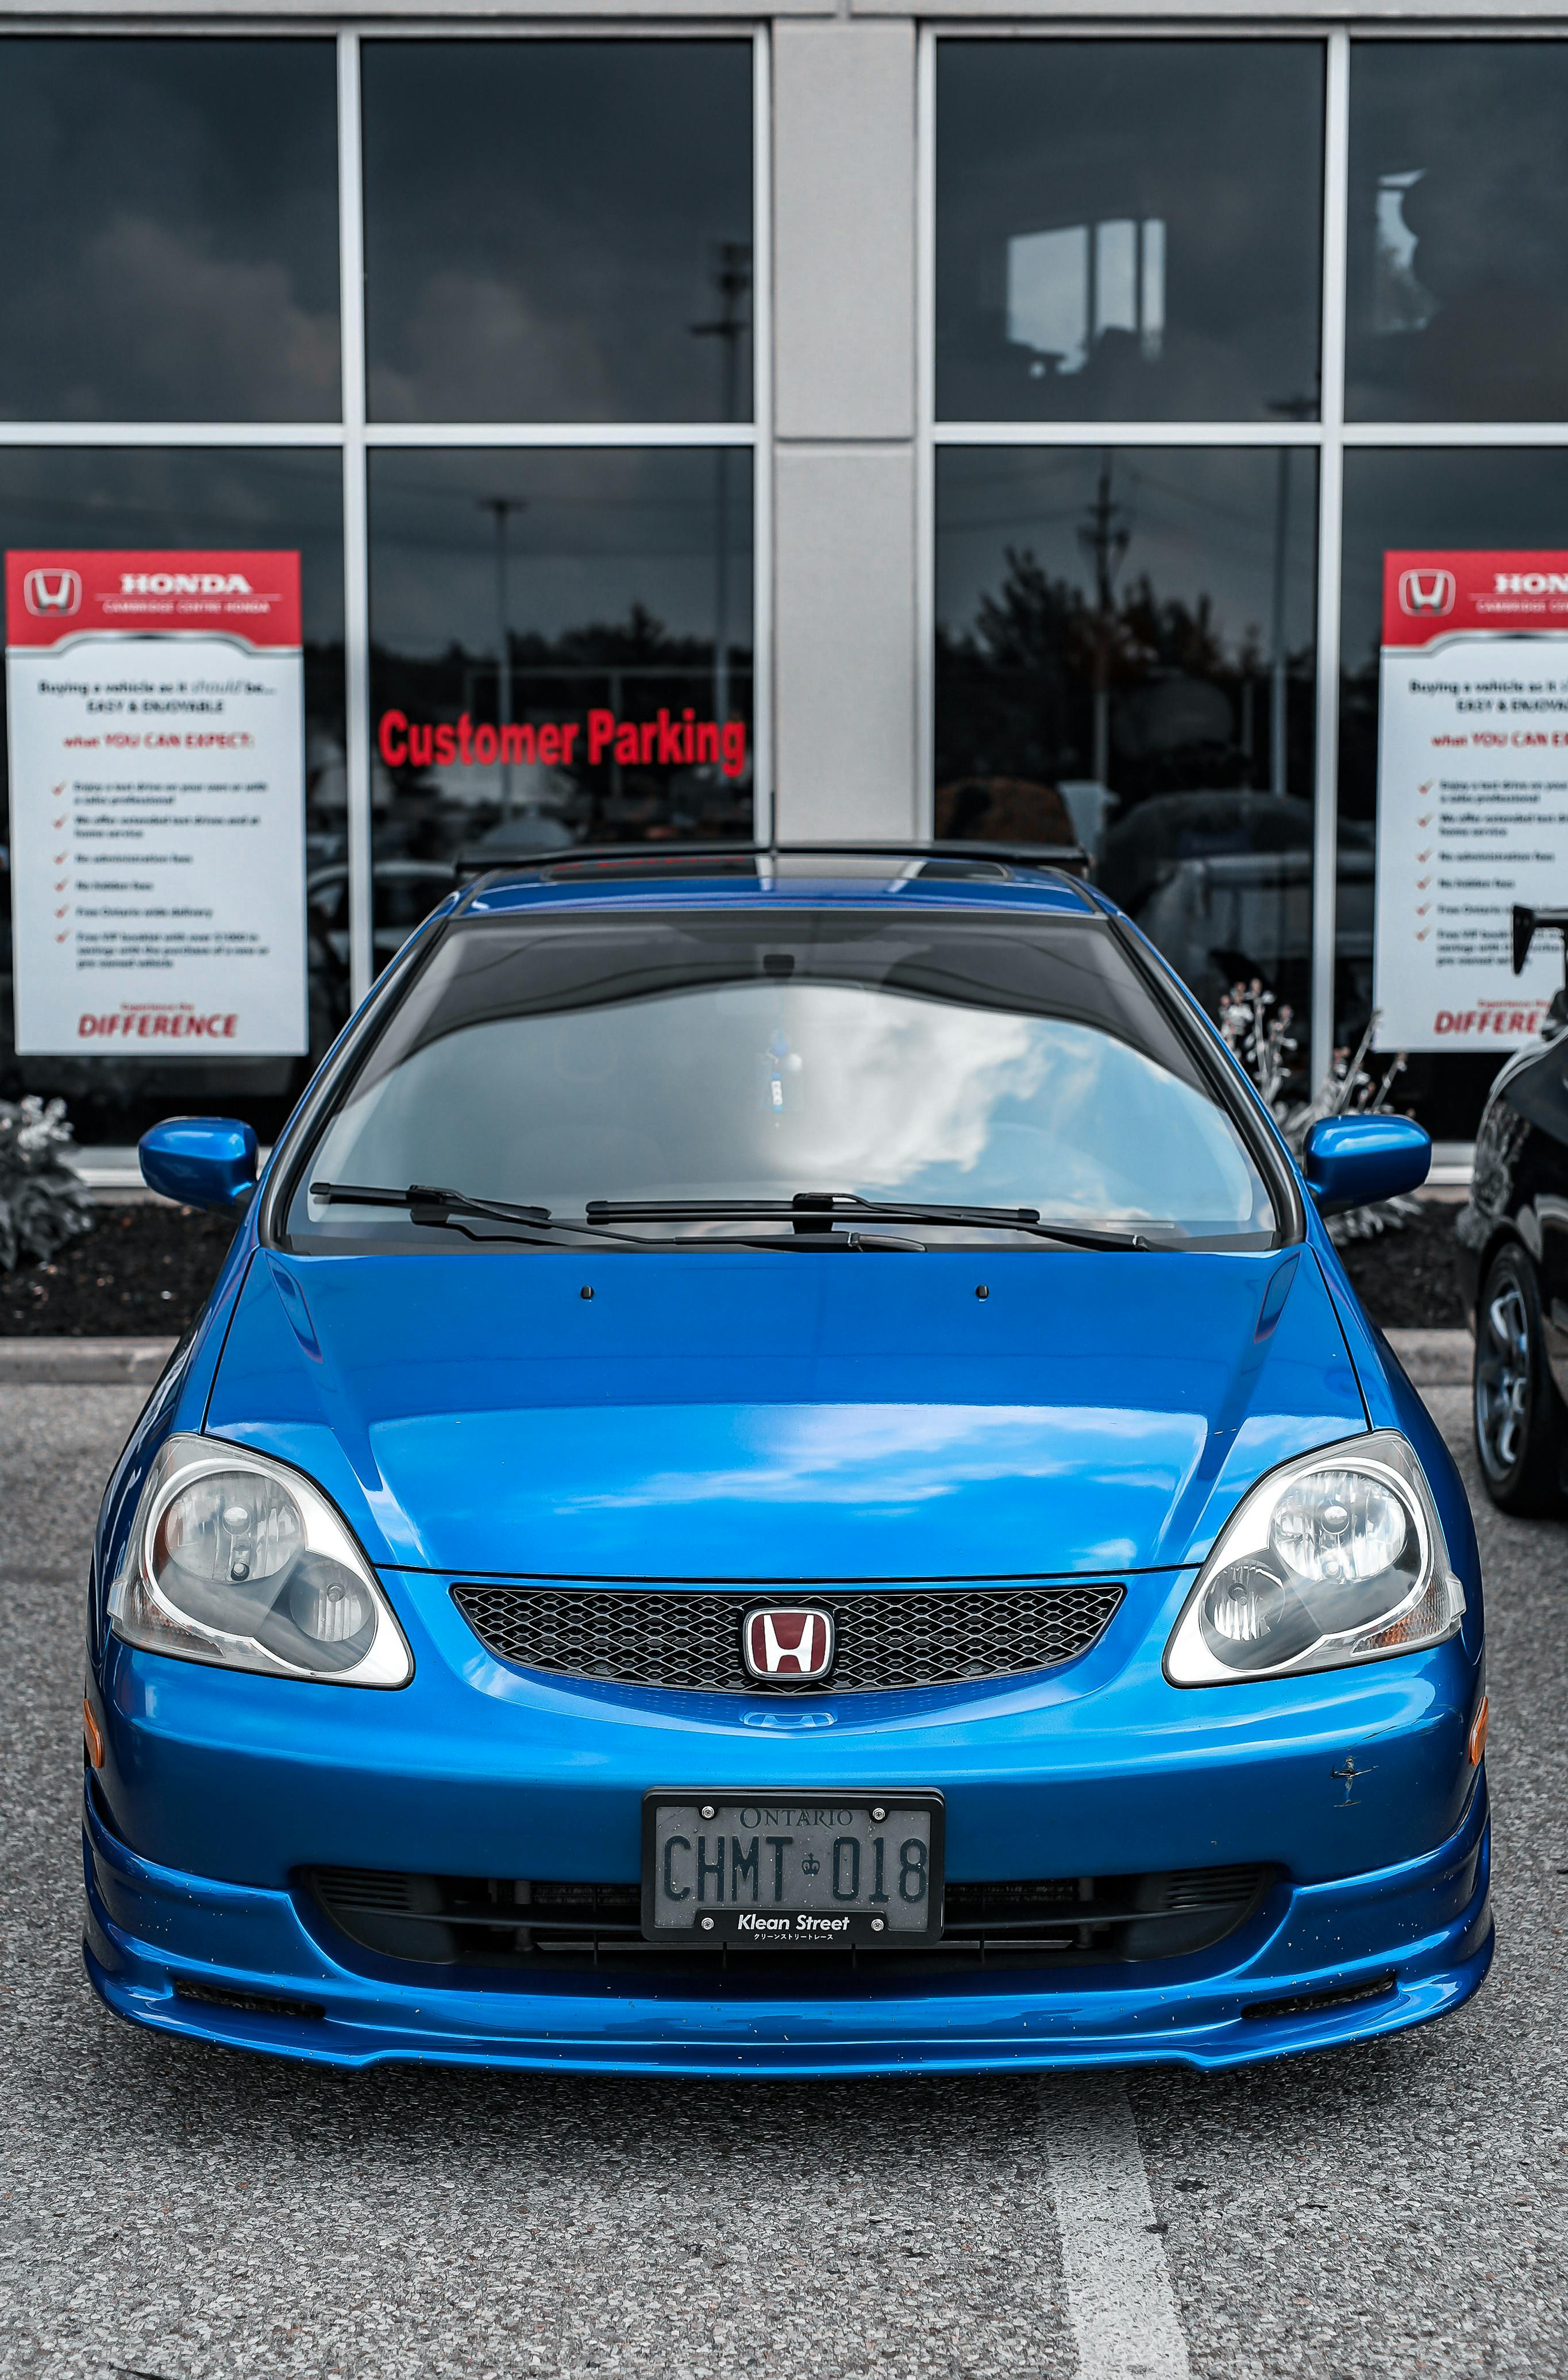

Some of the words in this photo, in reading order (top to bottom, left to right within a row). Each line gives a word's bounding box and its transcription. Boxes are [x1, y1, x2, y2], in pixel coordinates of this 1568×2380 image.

[121, 575, 253, 593] HONDA
[1494, 574, 1568, 593] HON
[37, 680, 90, 697] Buying
[103, 680, 157, 695] vehicle
[103, 732, 140, 749] YOU
[143, 732, 183, 749] CAN
[379, 709, 579, 766] Customer
[588, 708, 745, 777] Parking
[1470, 731, 1508, 747] YOU
[1510, 731, 1549, 747] CAN
[78, 1014, 239, 1037] DIFFERENCE
[1436, 1011, 1544, 1035] DIFFERE
[740, 1807, 853, 1829] ONTARIO
[664, 1835, 793, 1902] CHMT
[833, 1837, 928, 1904] 018
[738, 1914, 789, 1930] Klean
[796, 1915, 850, 1930] Street
